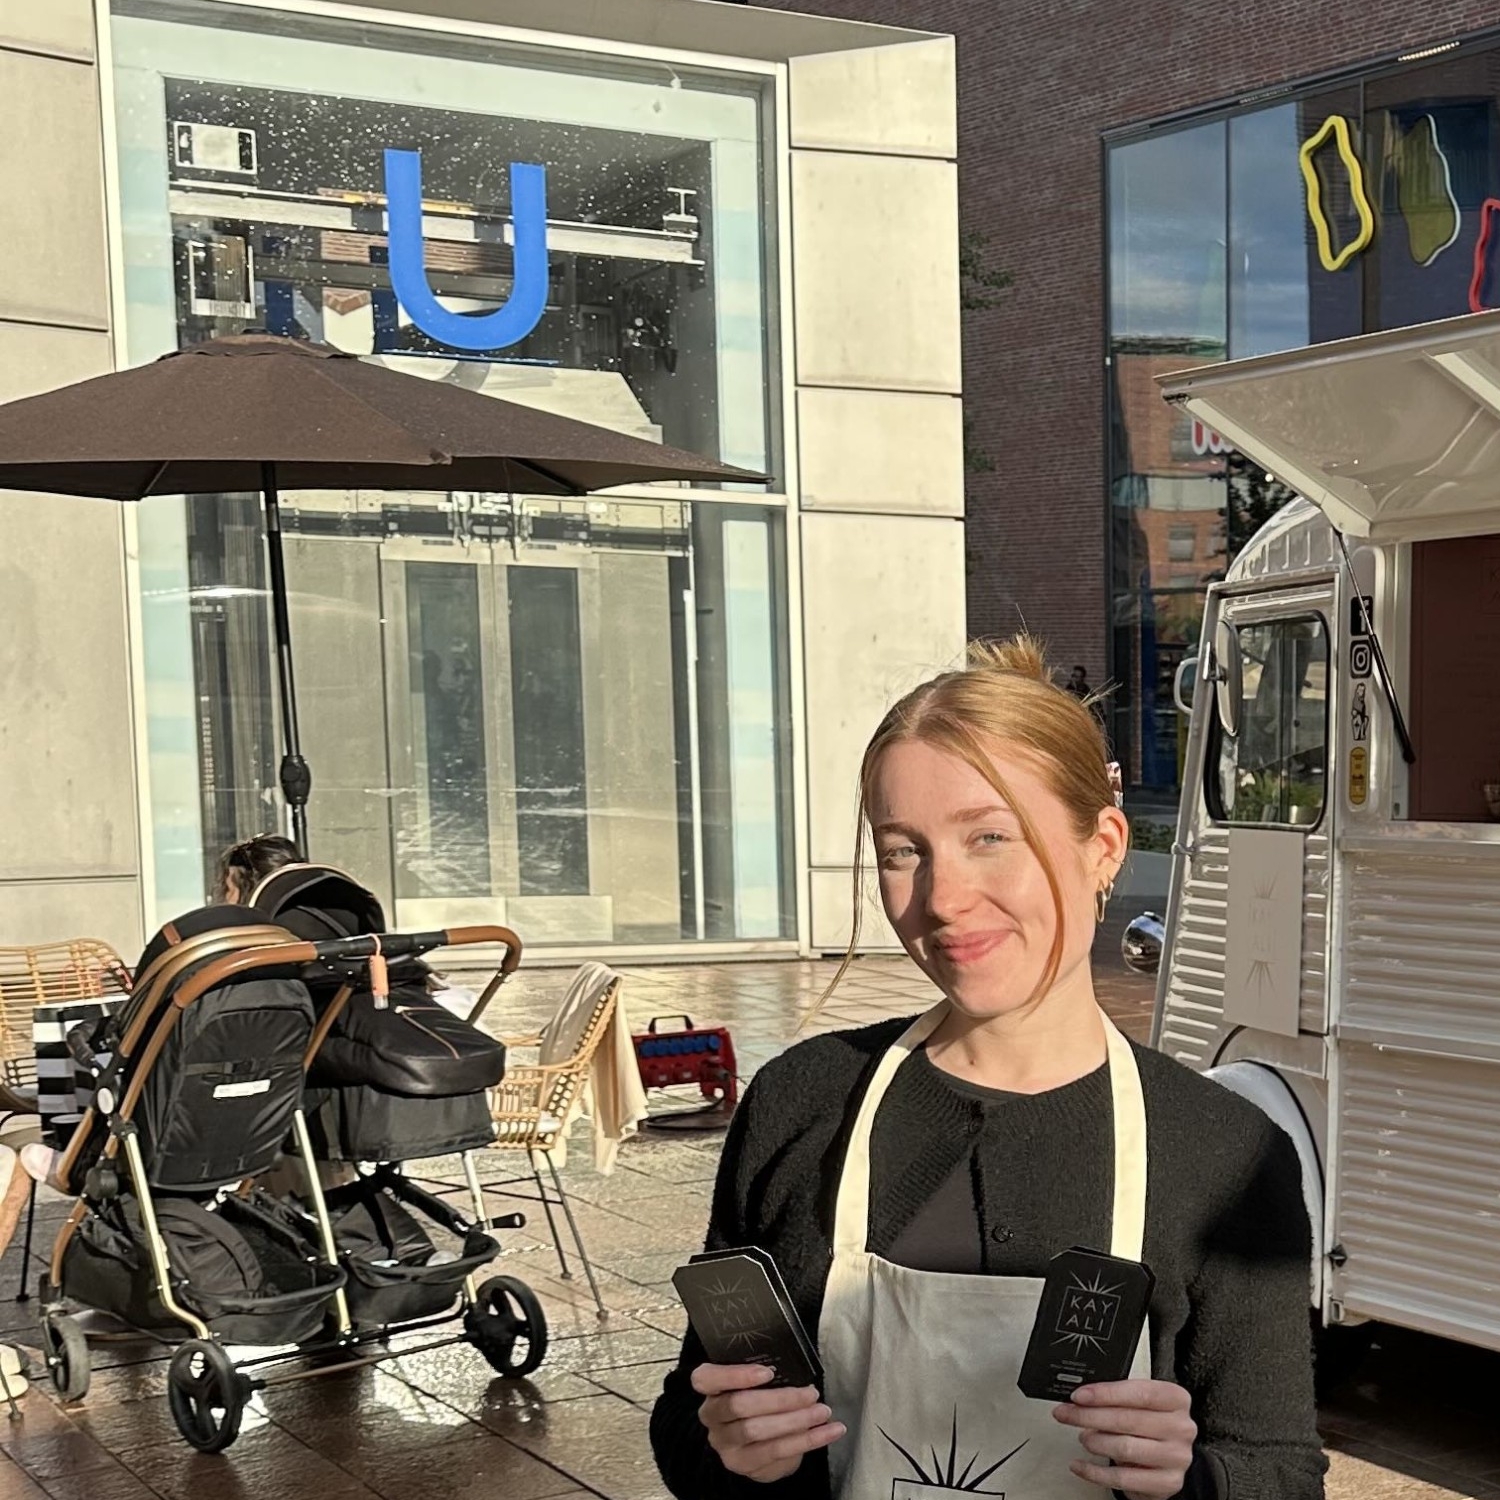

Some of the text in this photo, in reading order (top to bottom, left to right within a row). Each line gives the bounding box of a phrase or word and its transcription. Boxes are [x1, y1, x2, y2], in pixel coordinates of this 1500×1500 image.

[383, 148, 549, 350] U
[711, 1296, 750, 1315] KAY
[1070, 1294, 1114, 1315] KAY
[1065, 1314, 1104, 1331] ALI
